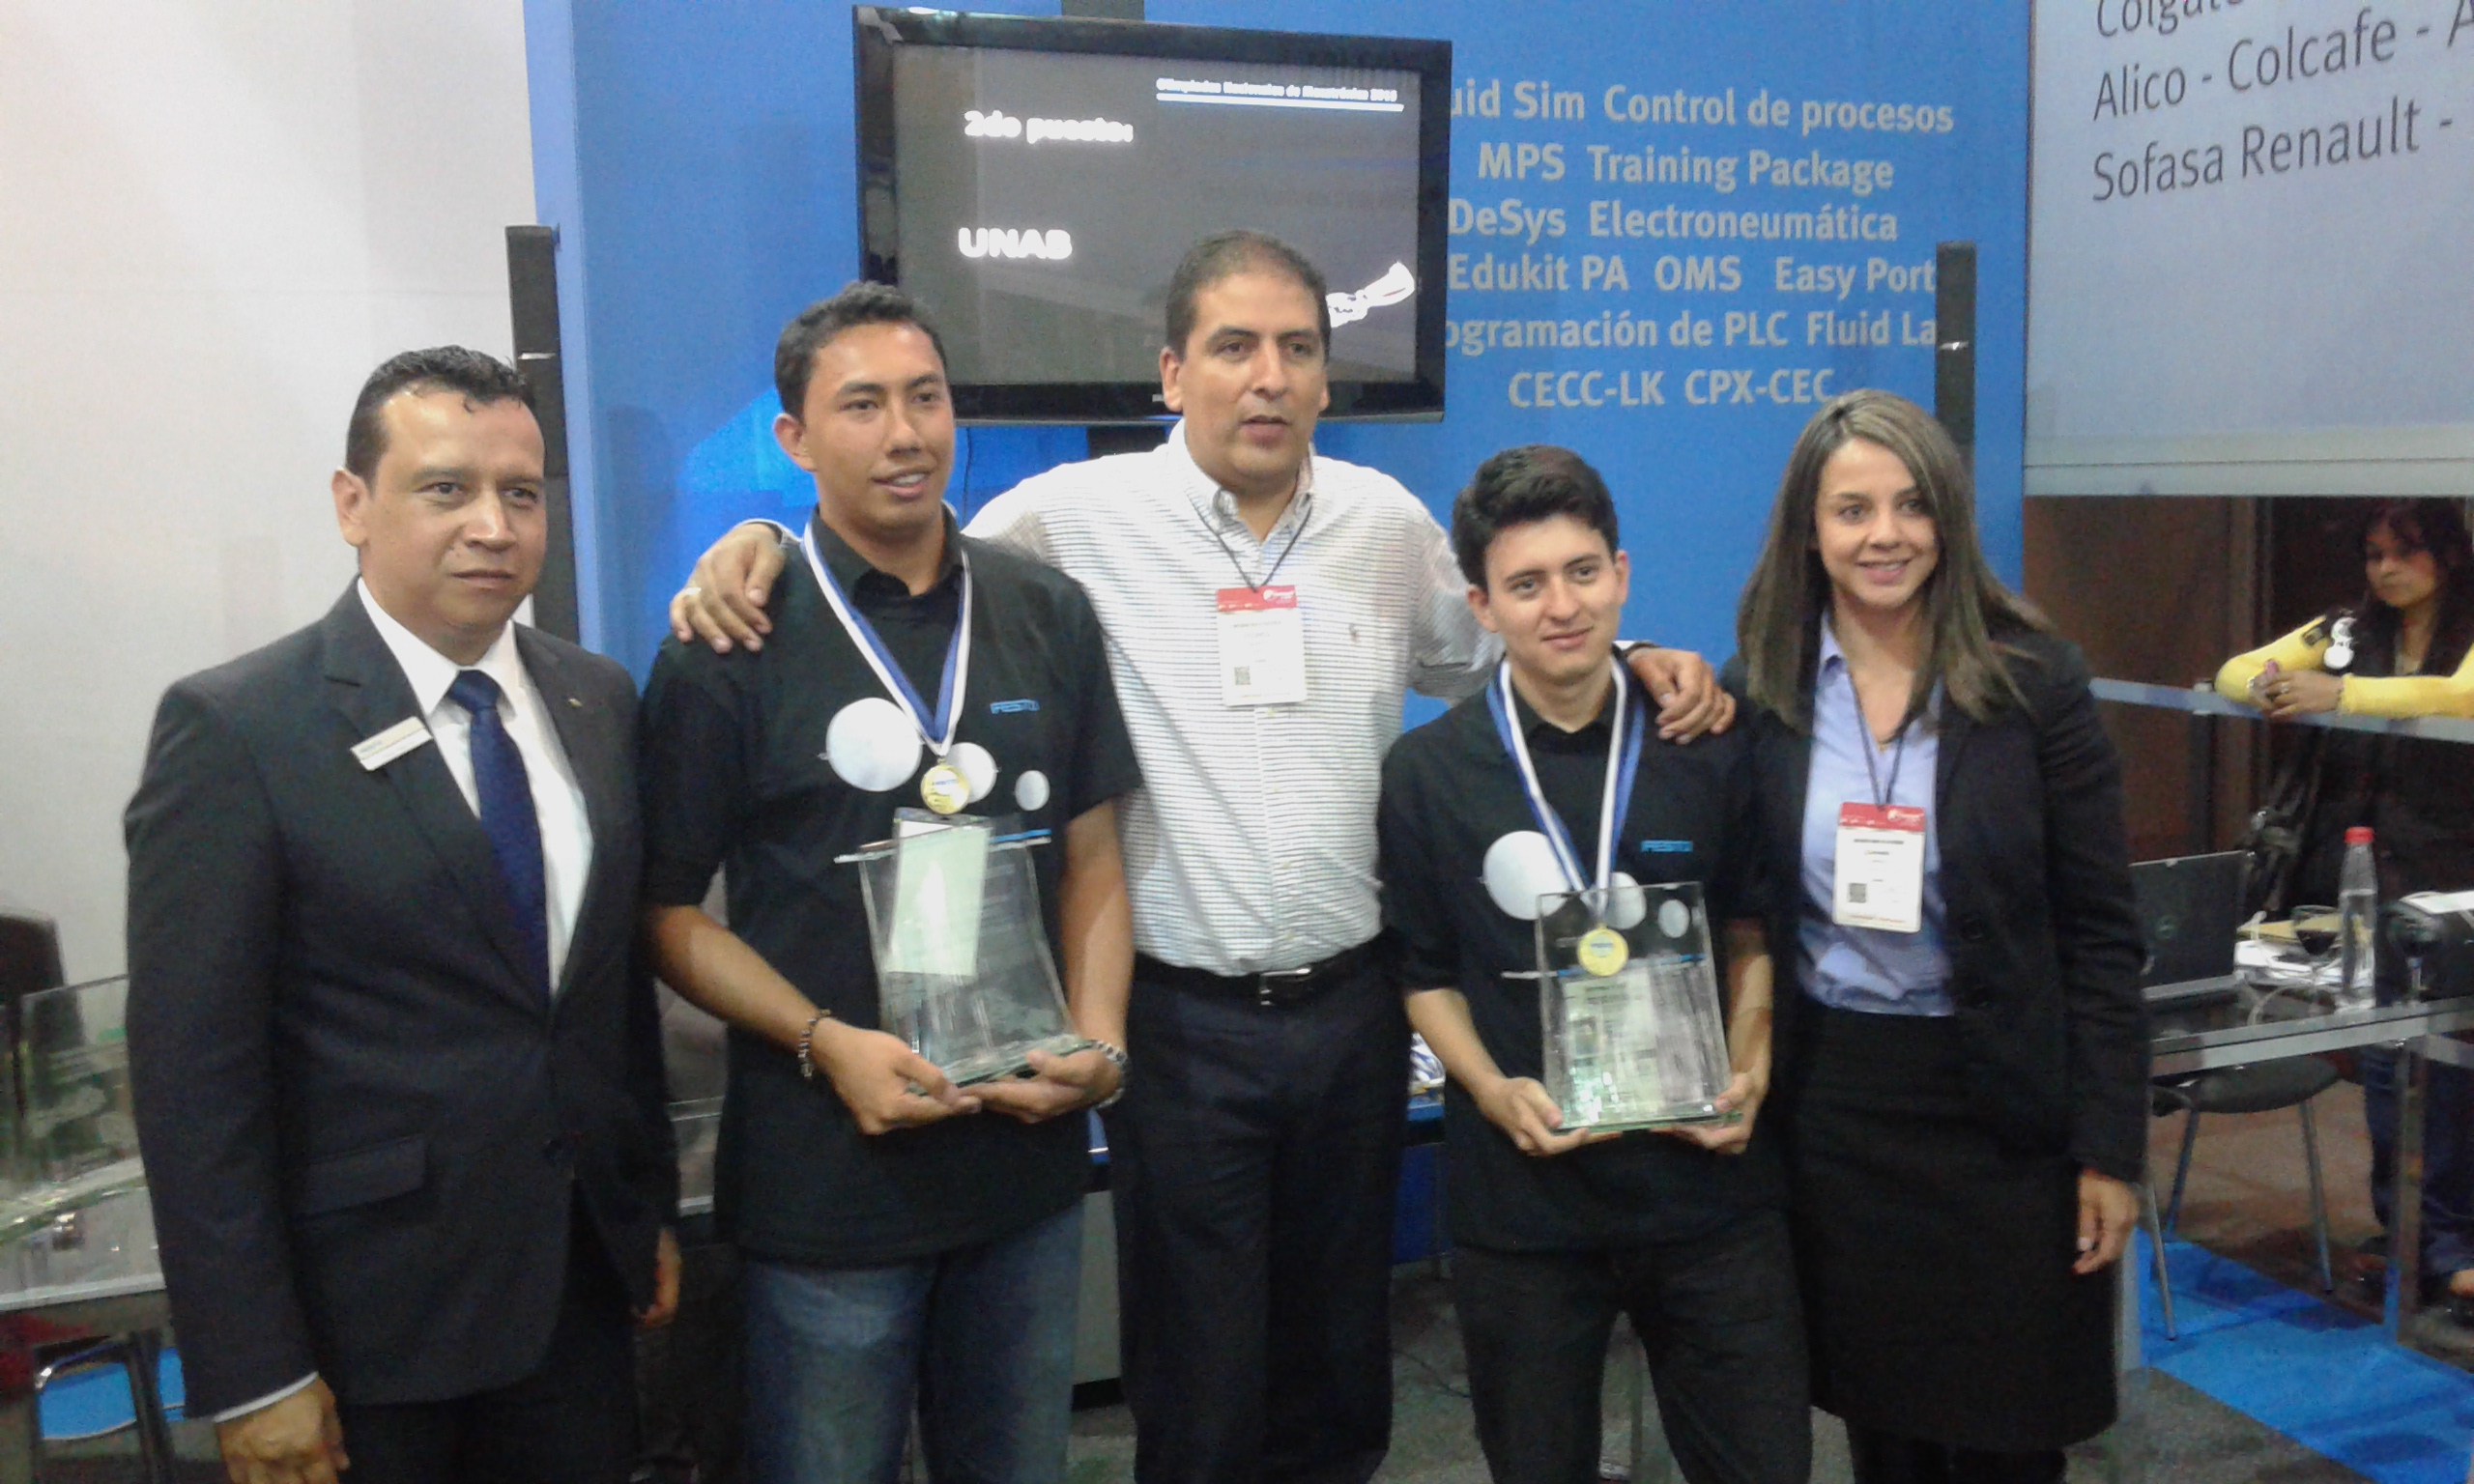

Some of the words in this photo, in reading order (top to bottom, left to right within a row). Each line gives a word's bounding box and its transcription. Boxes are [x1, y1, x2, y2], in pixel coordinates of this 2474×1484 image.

[2093, 64, 2186, 122] Alico
[2229, 6, 2397, 91] Colcafe
[964, 109, 1022, 137] 2do
[1513, 81, 1585, 121] Sim
[1603, 85, 1736, 126] Control
[1746, 91, 1791, 128] de
[1801, 101, 1954, 137] procesos
[1479, 142, 1566, 182] MPS
[1587, 145, 1739, 193] Training
[1748, 150, 1894, 197] Package
[2092, 141, 2224, 202] Sofasa
[2242, 96, 2421, 178] Renault
[958, 226, 1074, 260] UNAB
[1448, 198, 1567, 246] DeSys
[1590, 200, 1897, 242] Electroneumática
[1447, 252, 1568, 292] Edukit
[1581, 255, 1629, 291] PA
[1654, 255, 1742, 292] OMS
[1775, 257, 1856, 300] Easy
[1866, 257, 1936, 294] Port
[1669, 311, 1712, 347] de
[1725, 311, 1788, 347] PLC
[1807, 310, 1890, 346] Fluid
[1508, 371, 1664, 409] CECC-LK
[1684, 369, 1835, 404] CPX-CEC
